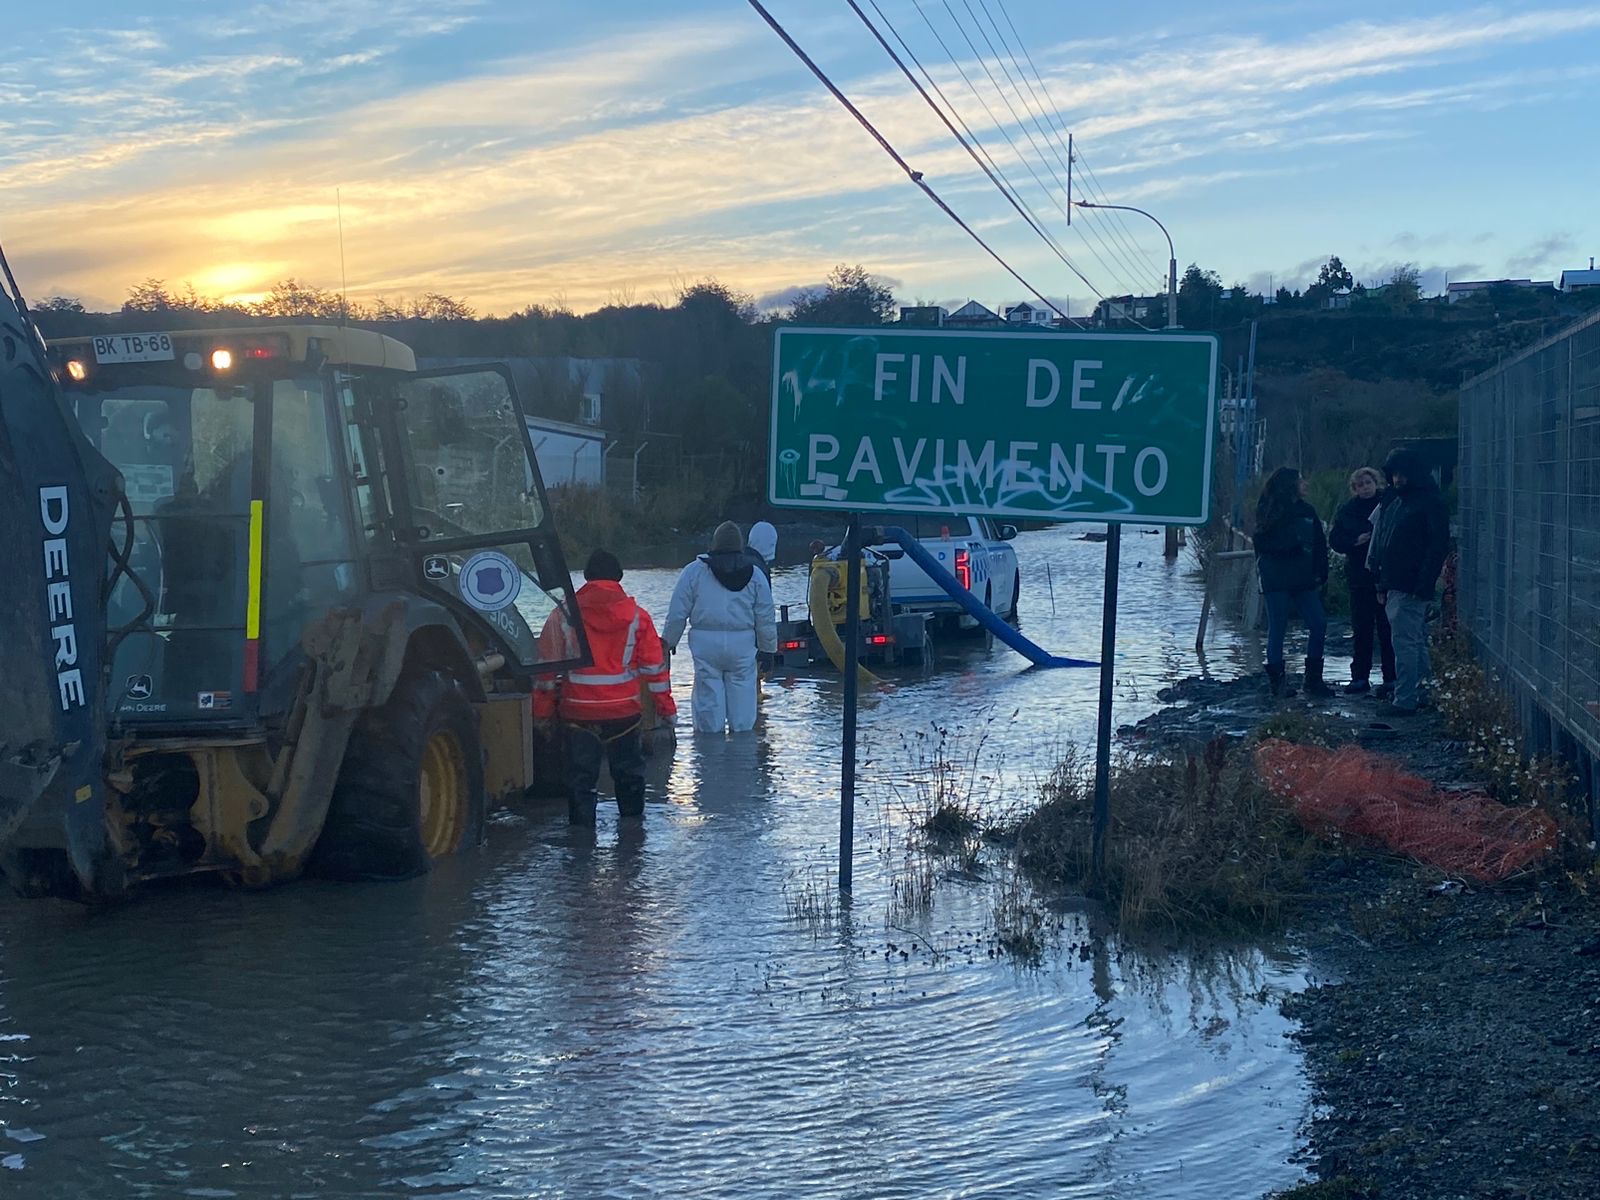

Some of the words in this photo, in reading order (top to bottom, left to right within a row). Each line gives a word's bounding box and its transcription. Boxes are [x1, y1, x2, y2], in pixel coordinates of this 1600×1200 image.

[95, 338, 117, 355] BK
[874, 353, 967, 405] FIN
[1026, 359, 1103, 410] DE
[808, 434, 1169, 497] PAVIMENTO
[40, 486, 85, 711] DEERE
